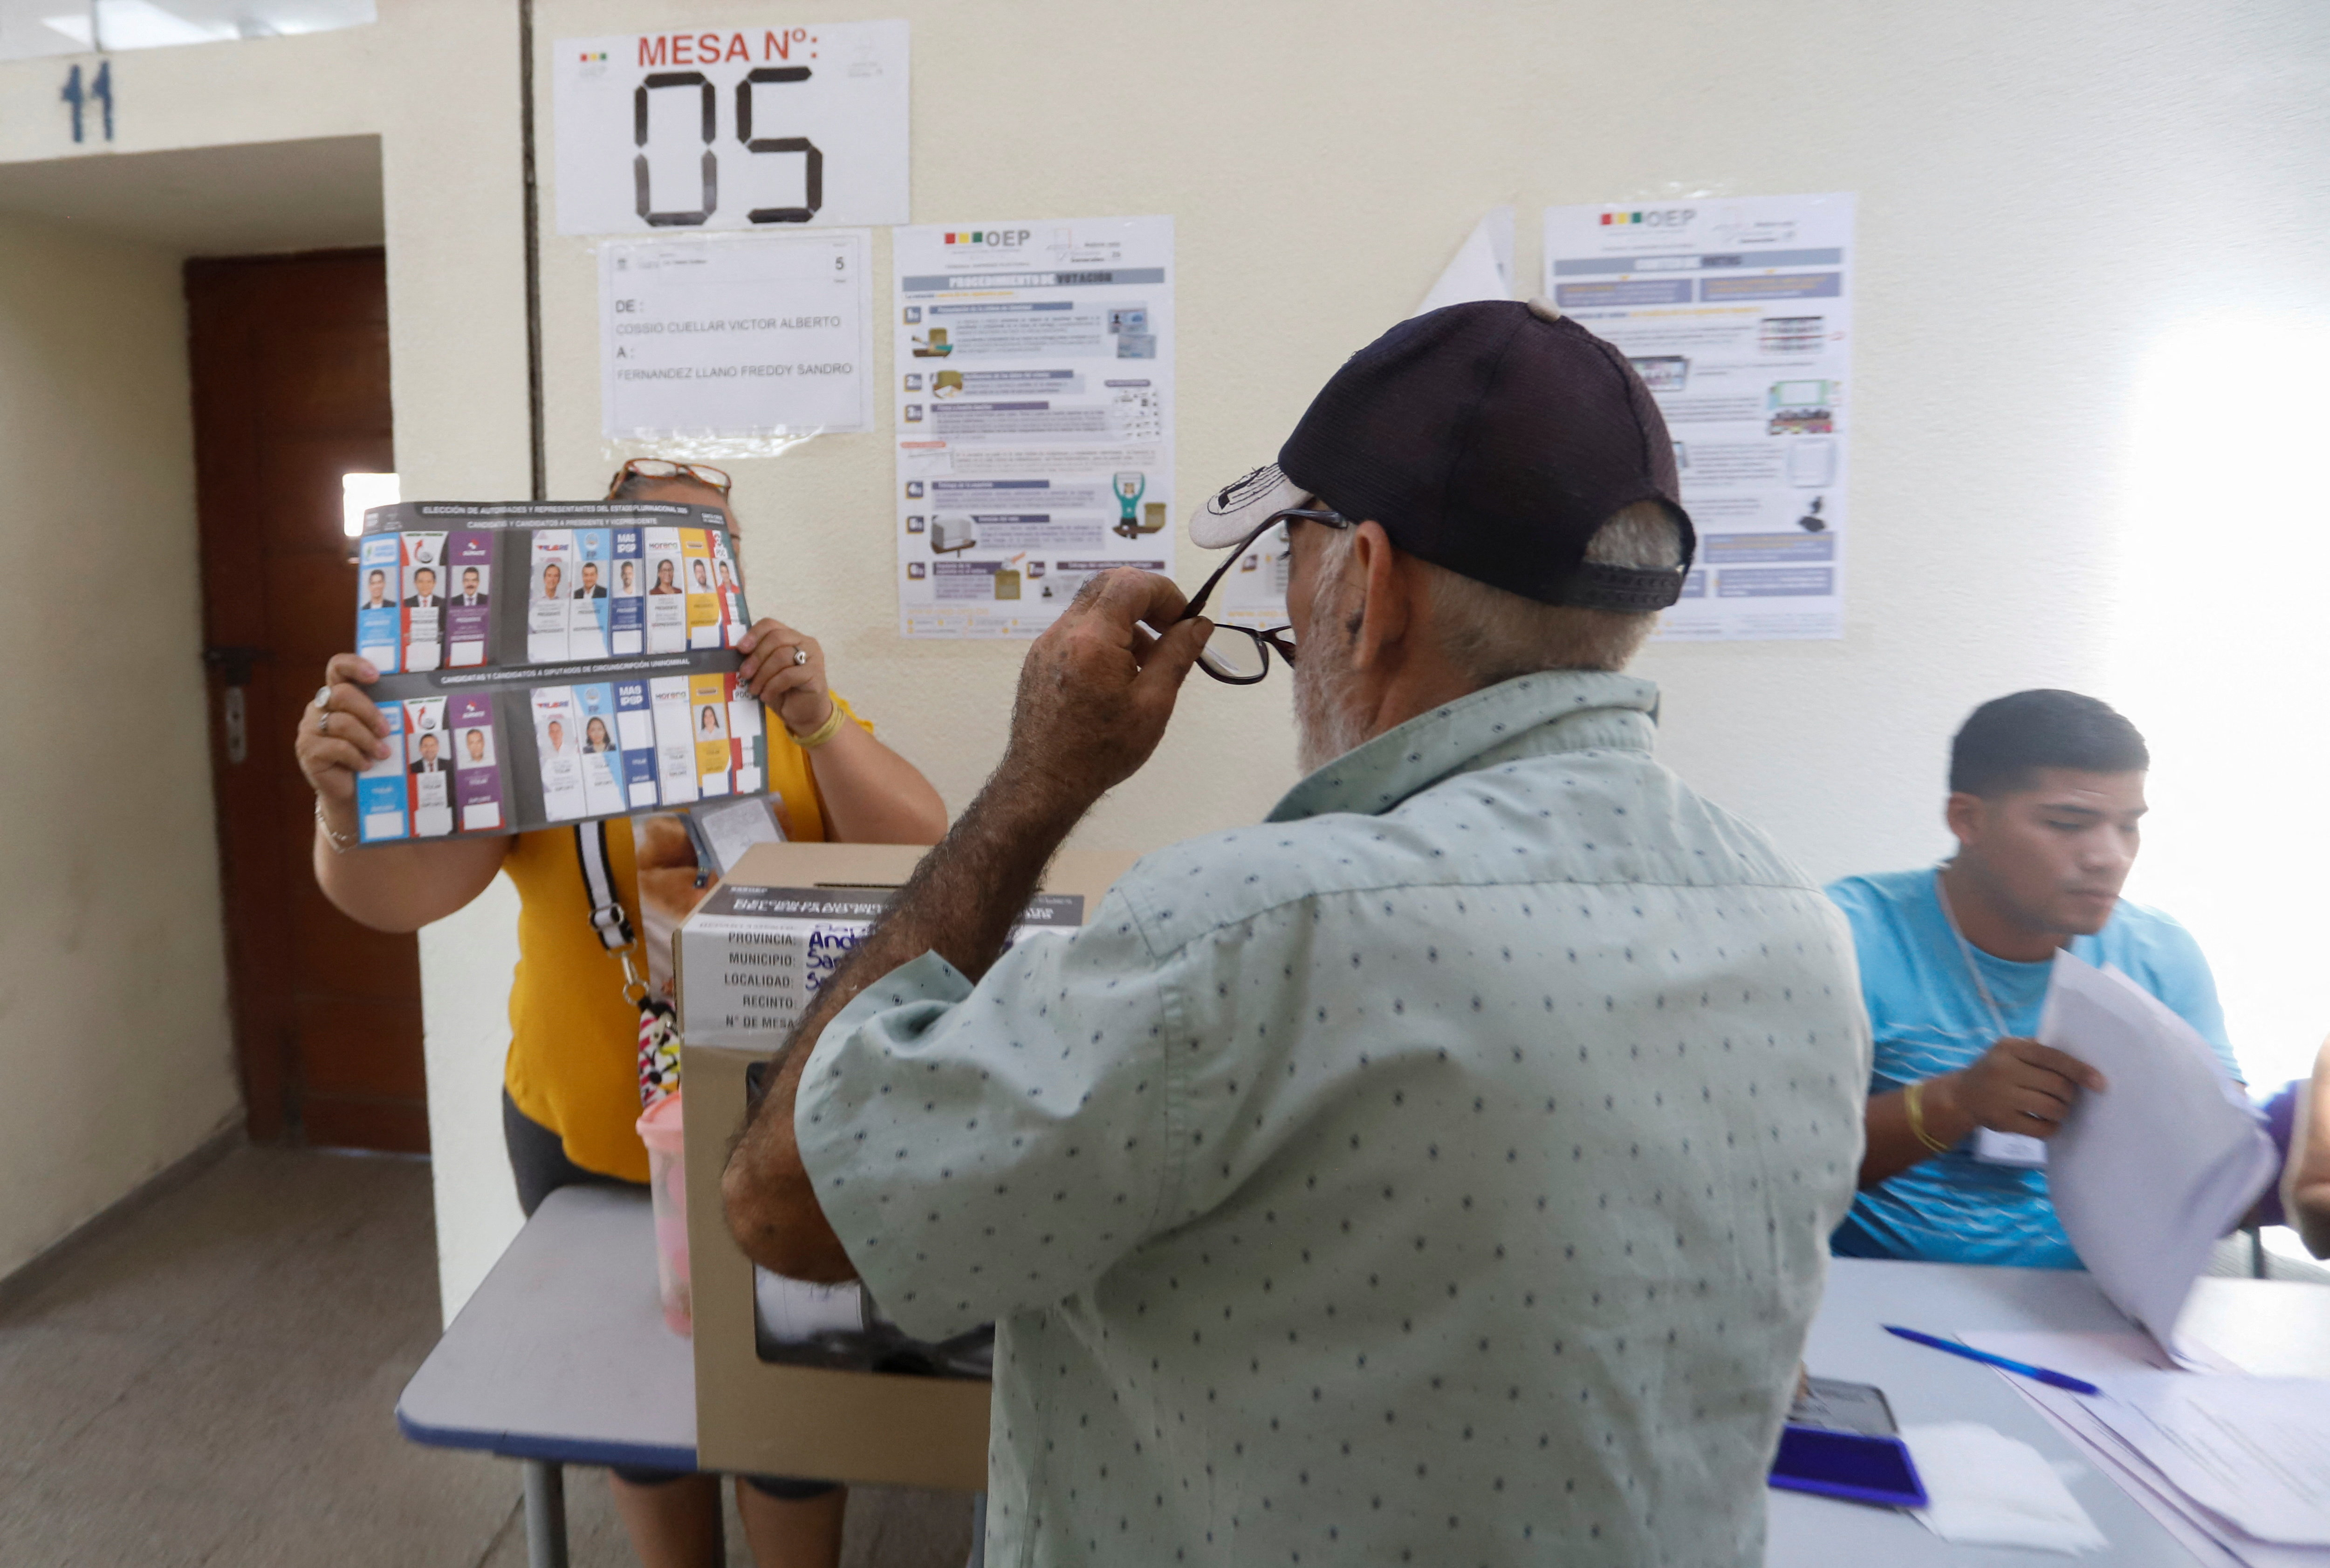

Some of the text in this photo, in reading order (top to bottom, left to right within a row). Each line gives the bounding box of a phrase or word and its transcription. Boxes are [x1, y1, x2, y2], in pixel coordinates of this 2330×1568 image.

[638, 32, 751, 67] MESA
[61, 60, 114, 143] 11
[634, 66, 822, 227] 05
[1647, 208, 1697, 227] OEP
[986, 230, 1030, 246] OEP
[835, 256, 844, 270] 5
[615, 300, 635, 313] DE
[616, 316, 841, 334] COSSIO CUELLAR VICTOR ALBERTO
[617, 346, 626, 358] A
[617, 362, 852, 381] FERNANDEZ LLANO FREDDY SANDRO
[617, 533, 636, 543] MAS
[619, 685, 642, 696] MAS
[728, 931, 795, 946] PROVINCIA:
[729, 952, 795, 967] MUNICIPIO:
[724, 972, 793, 988] LOCALIDAD:
[743, 995, 796, 1010] RECINTO:
[743, 1014, 758, 1028] DE
